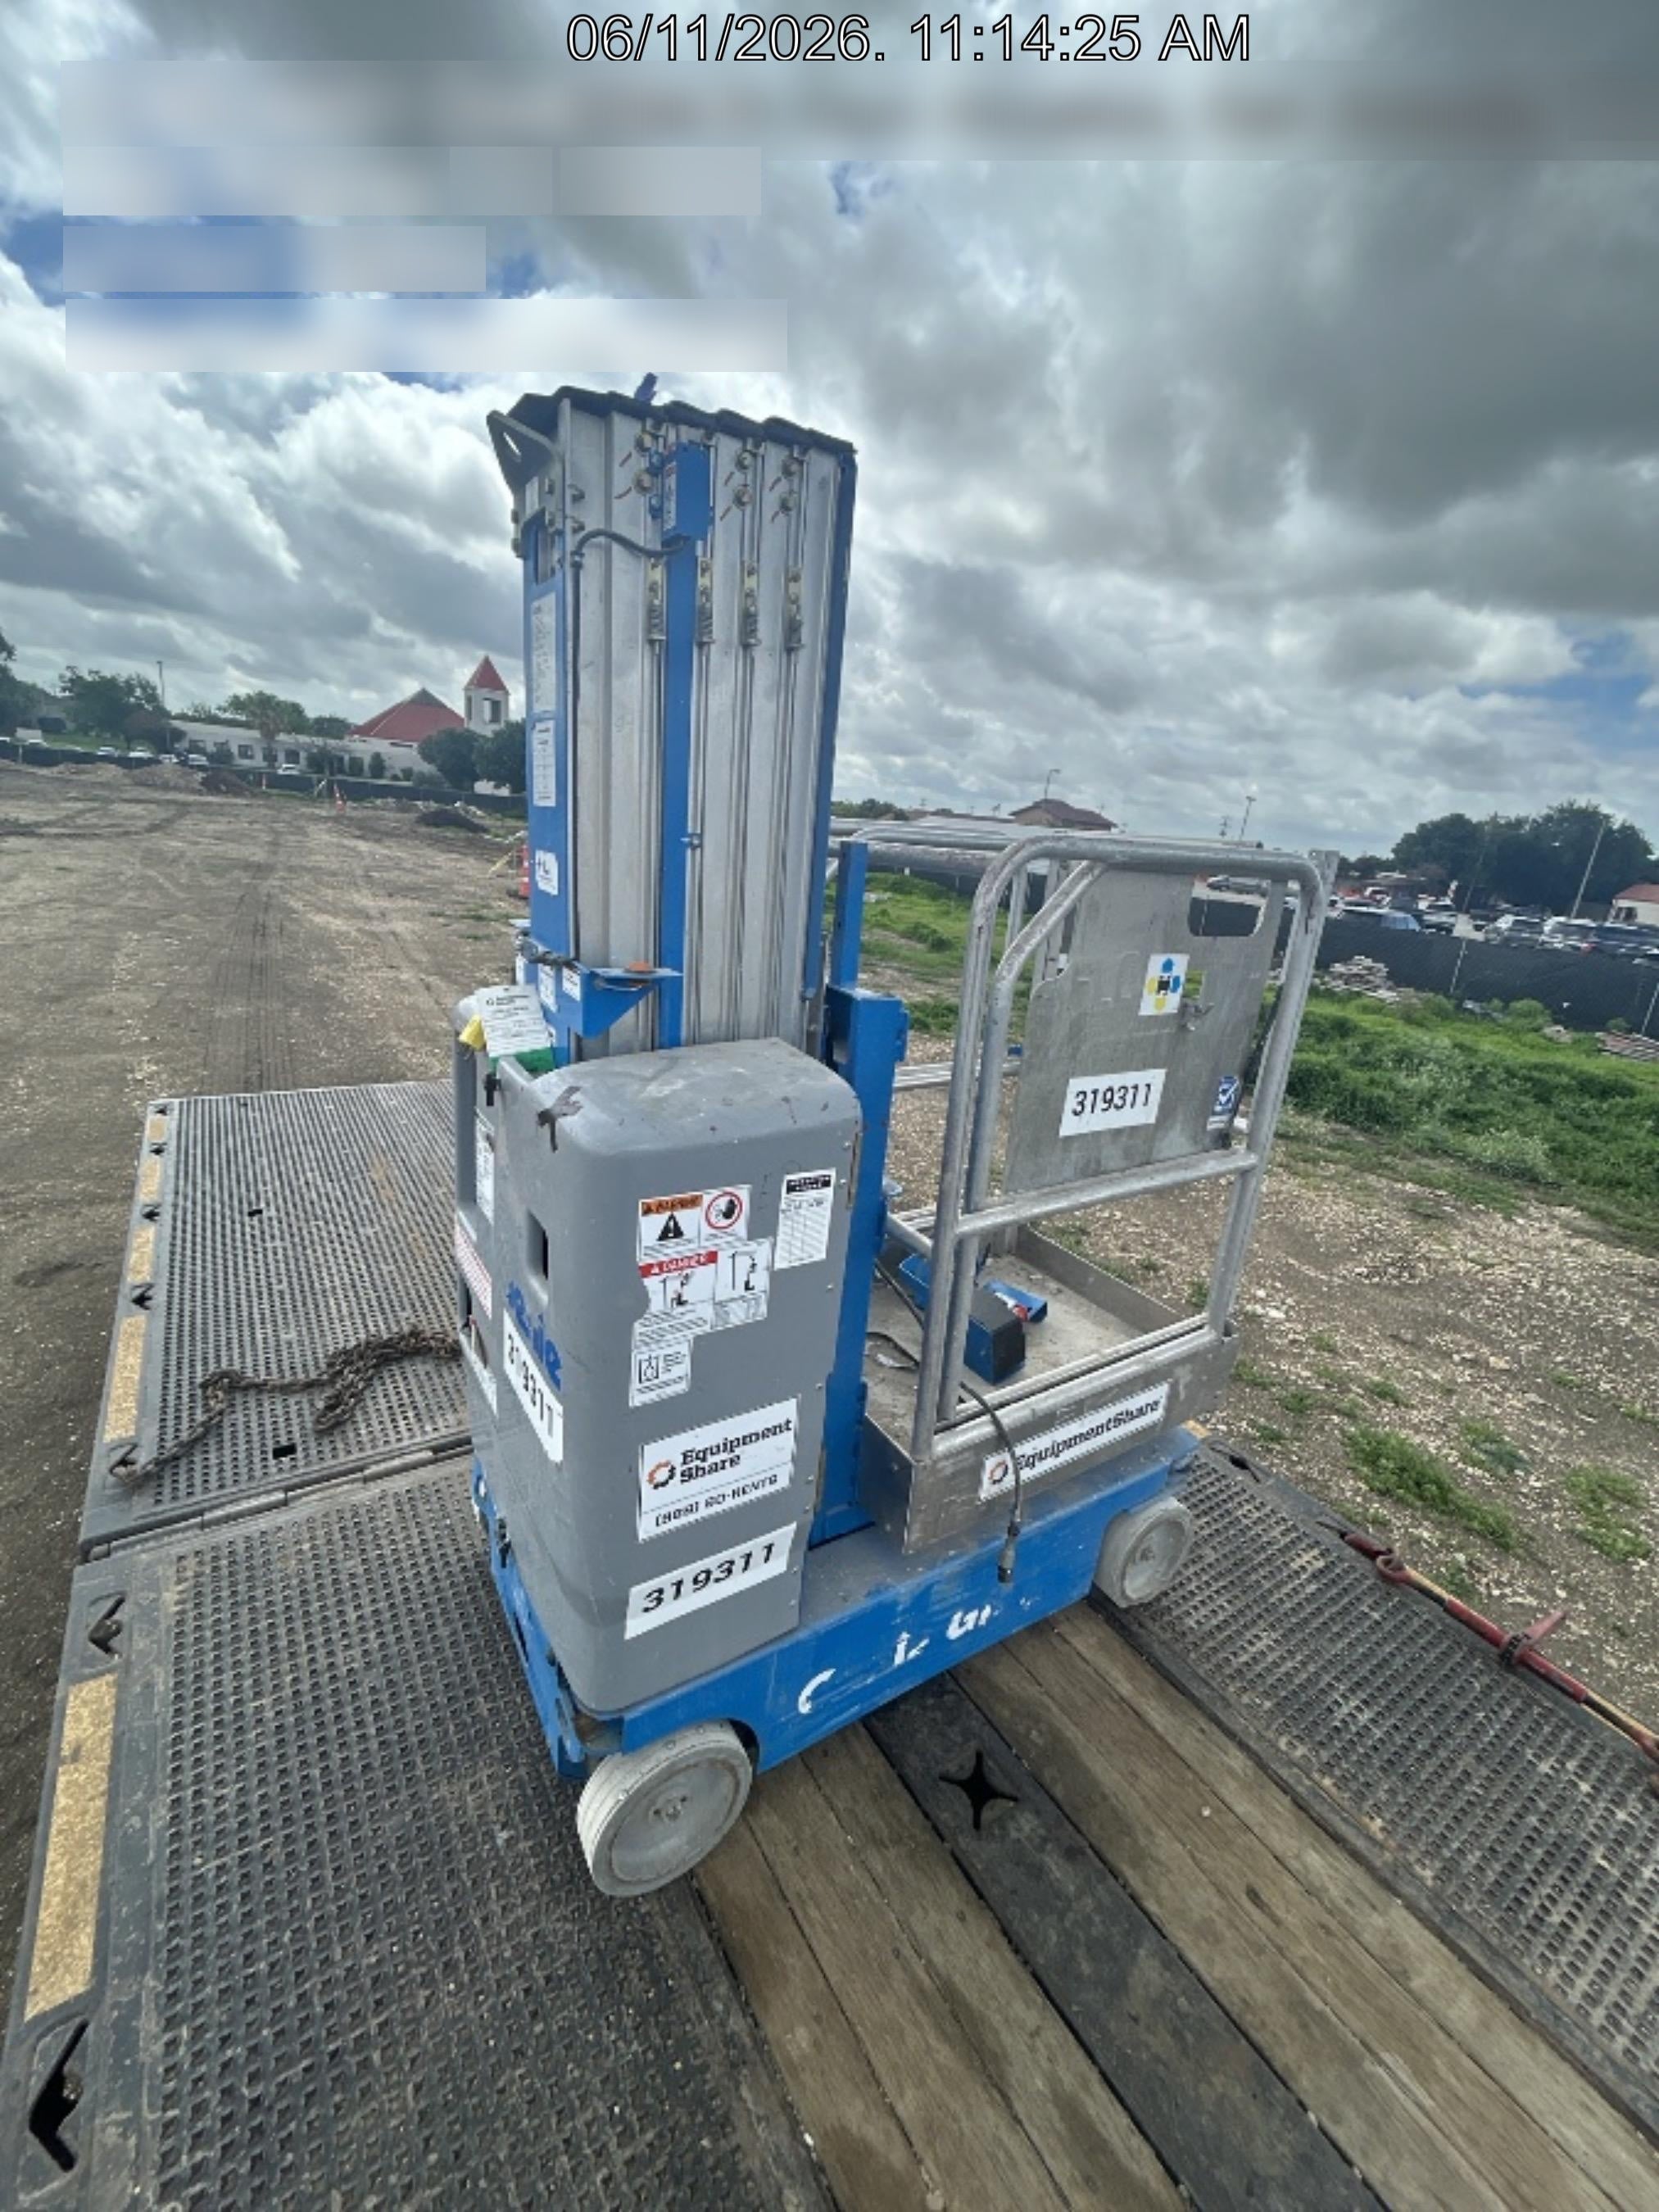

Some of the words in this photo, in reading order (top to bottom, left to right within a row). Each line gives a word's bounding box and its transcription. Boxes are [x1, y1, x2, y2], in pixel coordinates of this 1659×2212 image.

[1071, 1083, 1152, 1117] 319311
[680, 1417, 792, 1466] Equipment
[679, 1454, 741, 1484] Share
[641, 1542, 776, 1613] 319311
